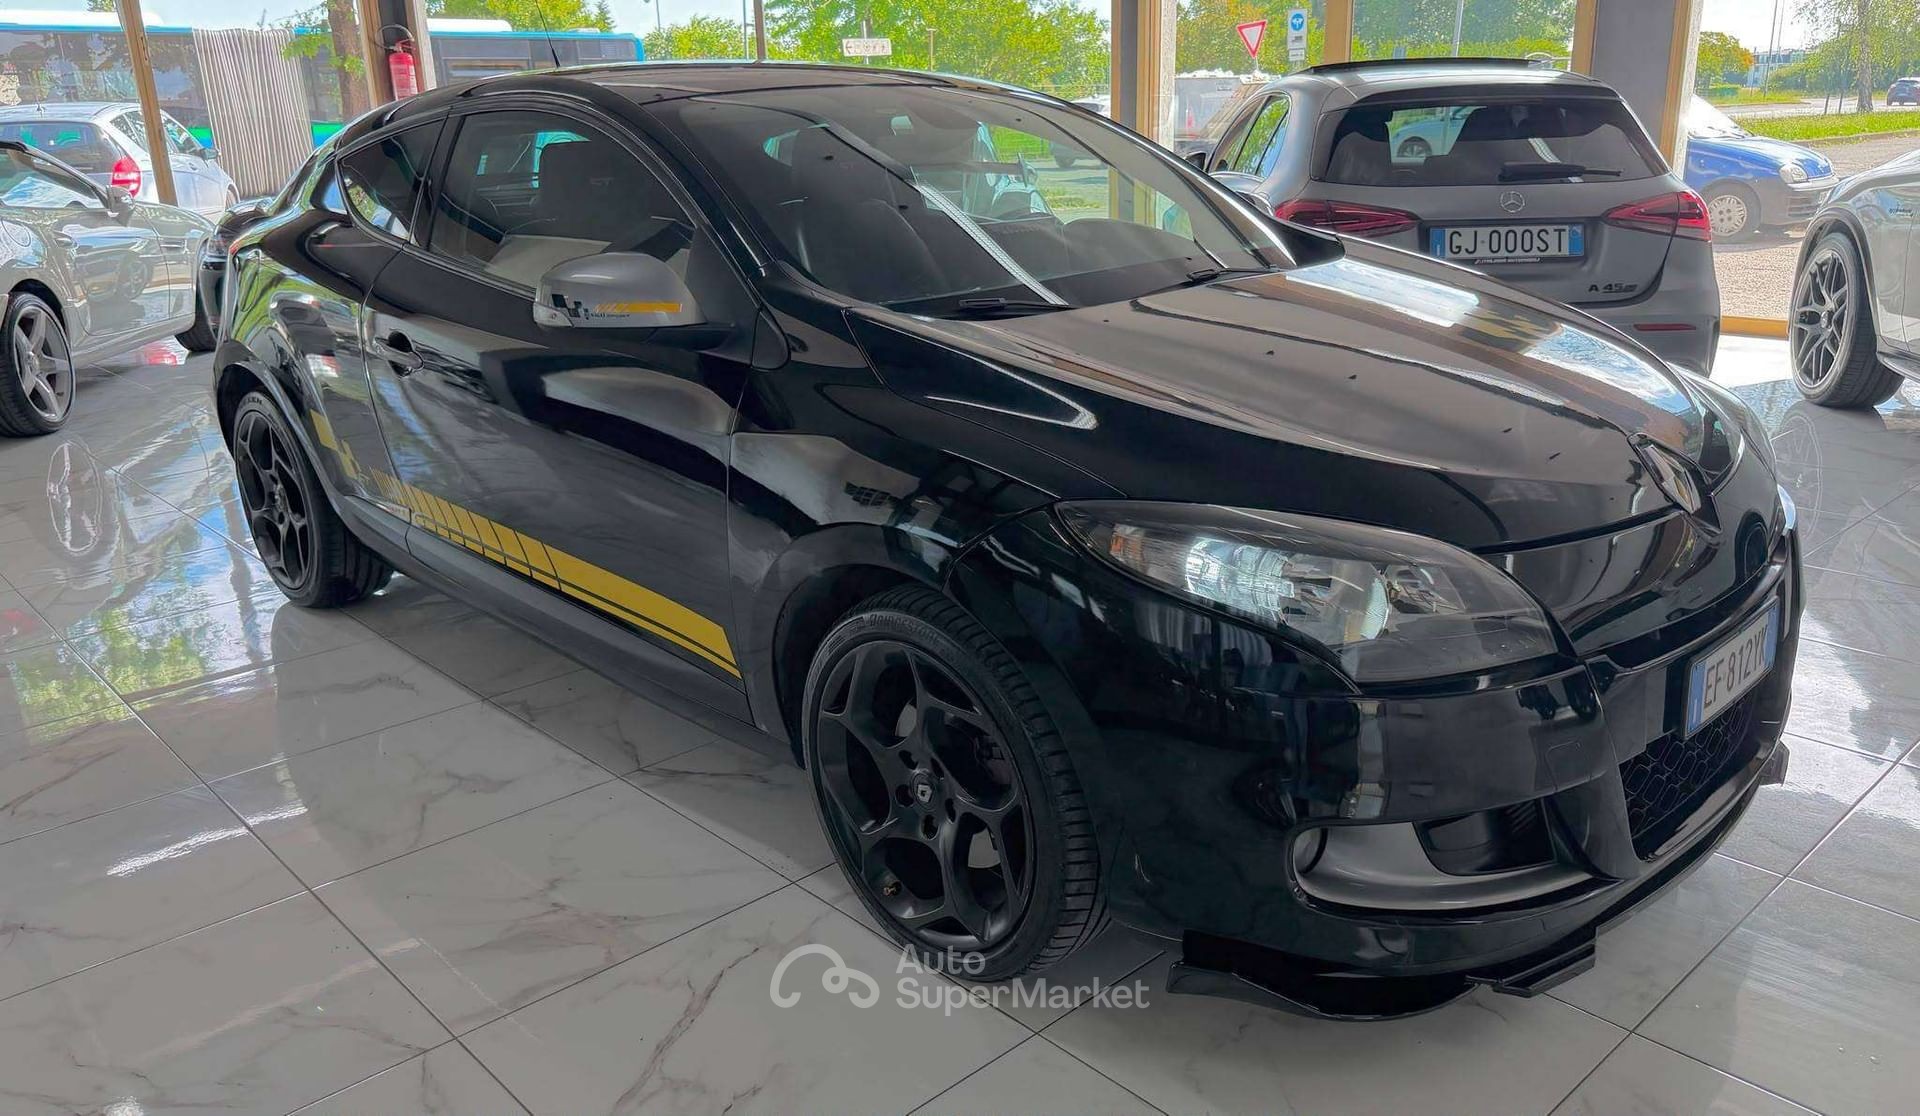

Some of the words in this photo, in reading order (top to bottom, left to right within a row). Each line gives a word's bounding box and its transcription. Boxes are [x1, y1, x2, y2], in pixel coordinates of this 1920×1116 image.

[1449, 230, 1478, 255] GJ
[1488, 228, 1567, 254] 000ST
[1588, 284, 1599, 292] A
[1704, 658, 1725, 708] EF
